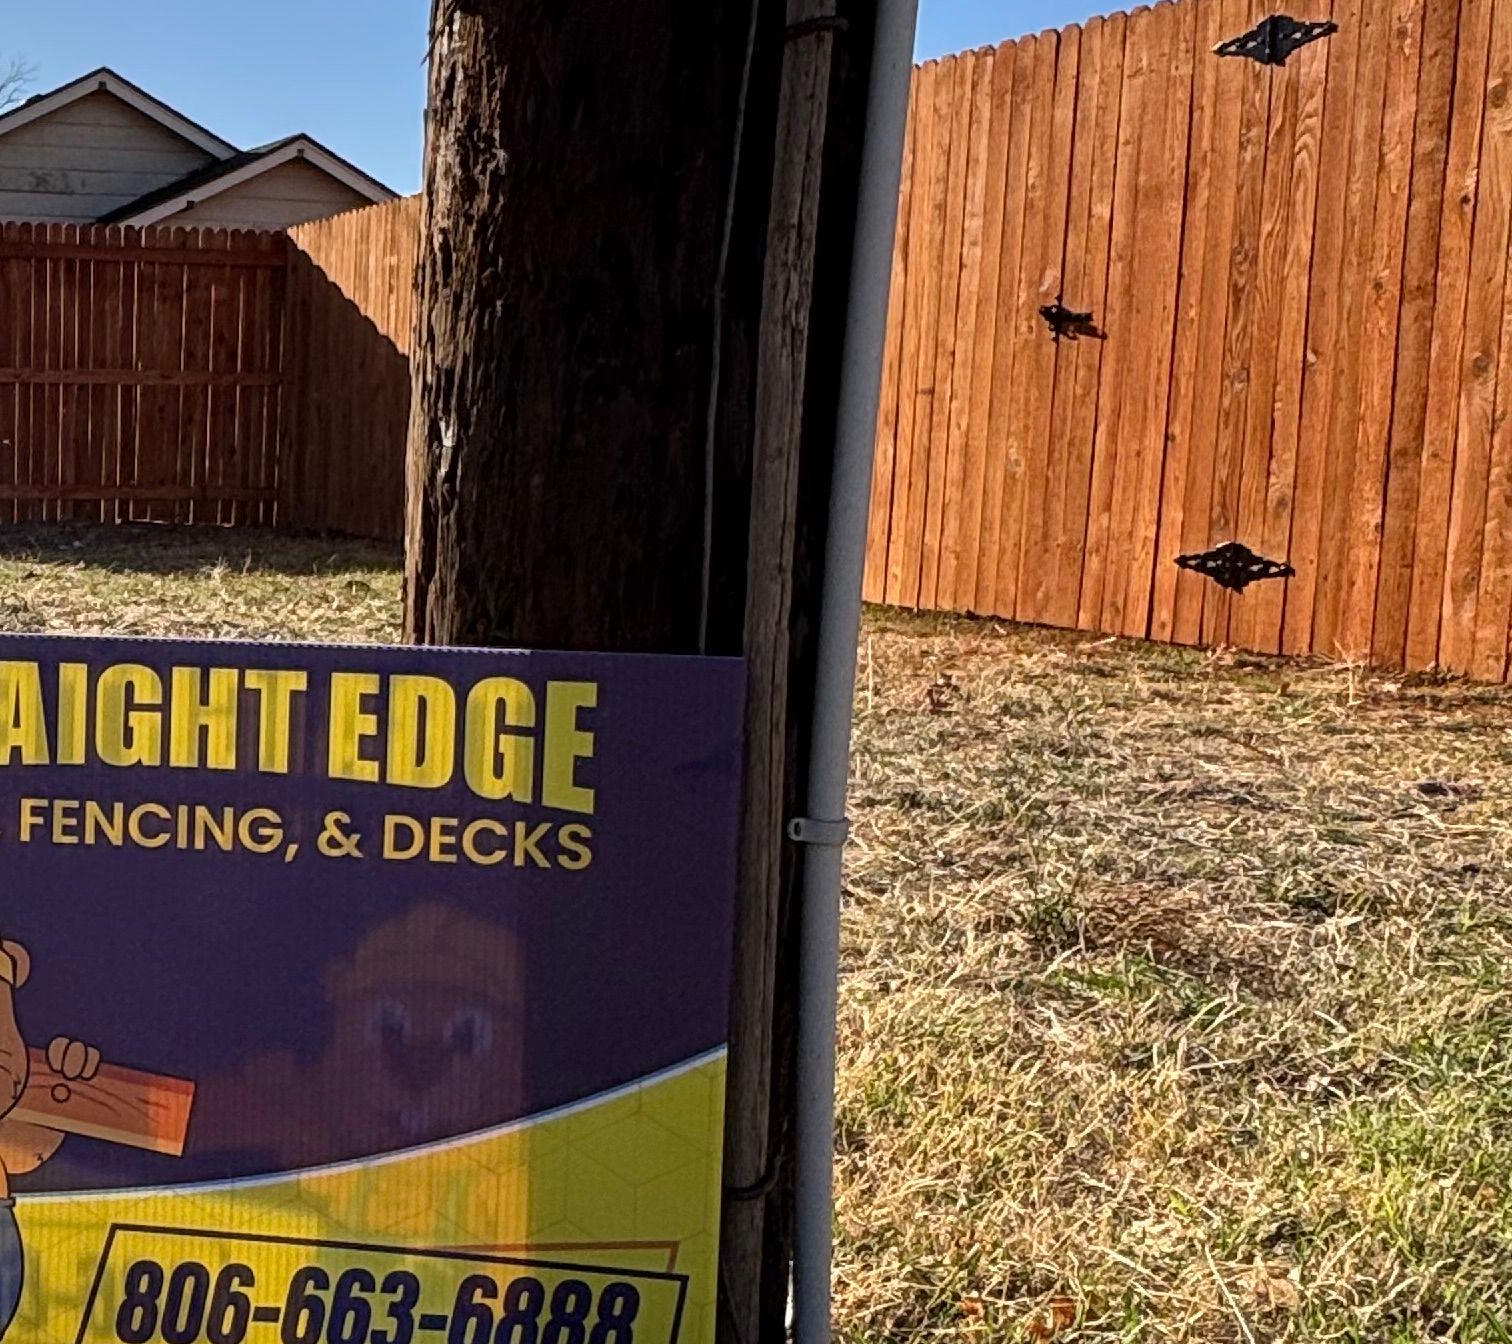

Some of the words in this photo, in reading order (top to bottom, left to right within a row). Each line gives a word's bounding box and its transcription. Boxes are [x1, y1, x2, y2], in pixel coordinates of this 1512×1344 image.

[327, 672, 597, 812] EDGE
[19, 797, 297, 860] FENCING,
[317, 811, 361, 856] &
[383, 815, 593, 868] DECKS
